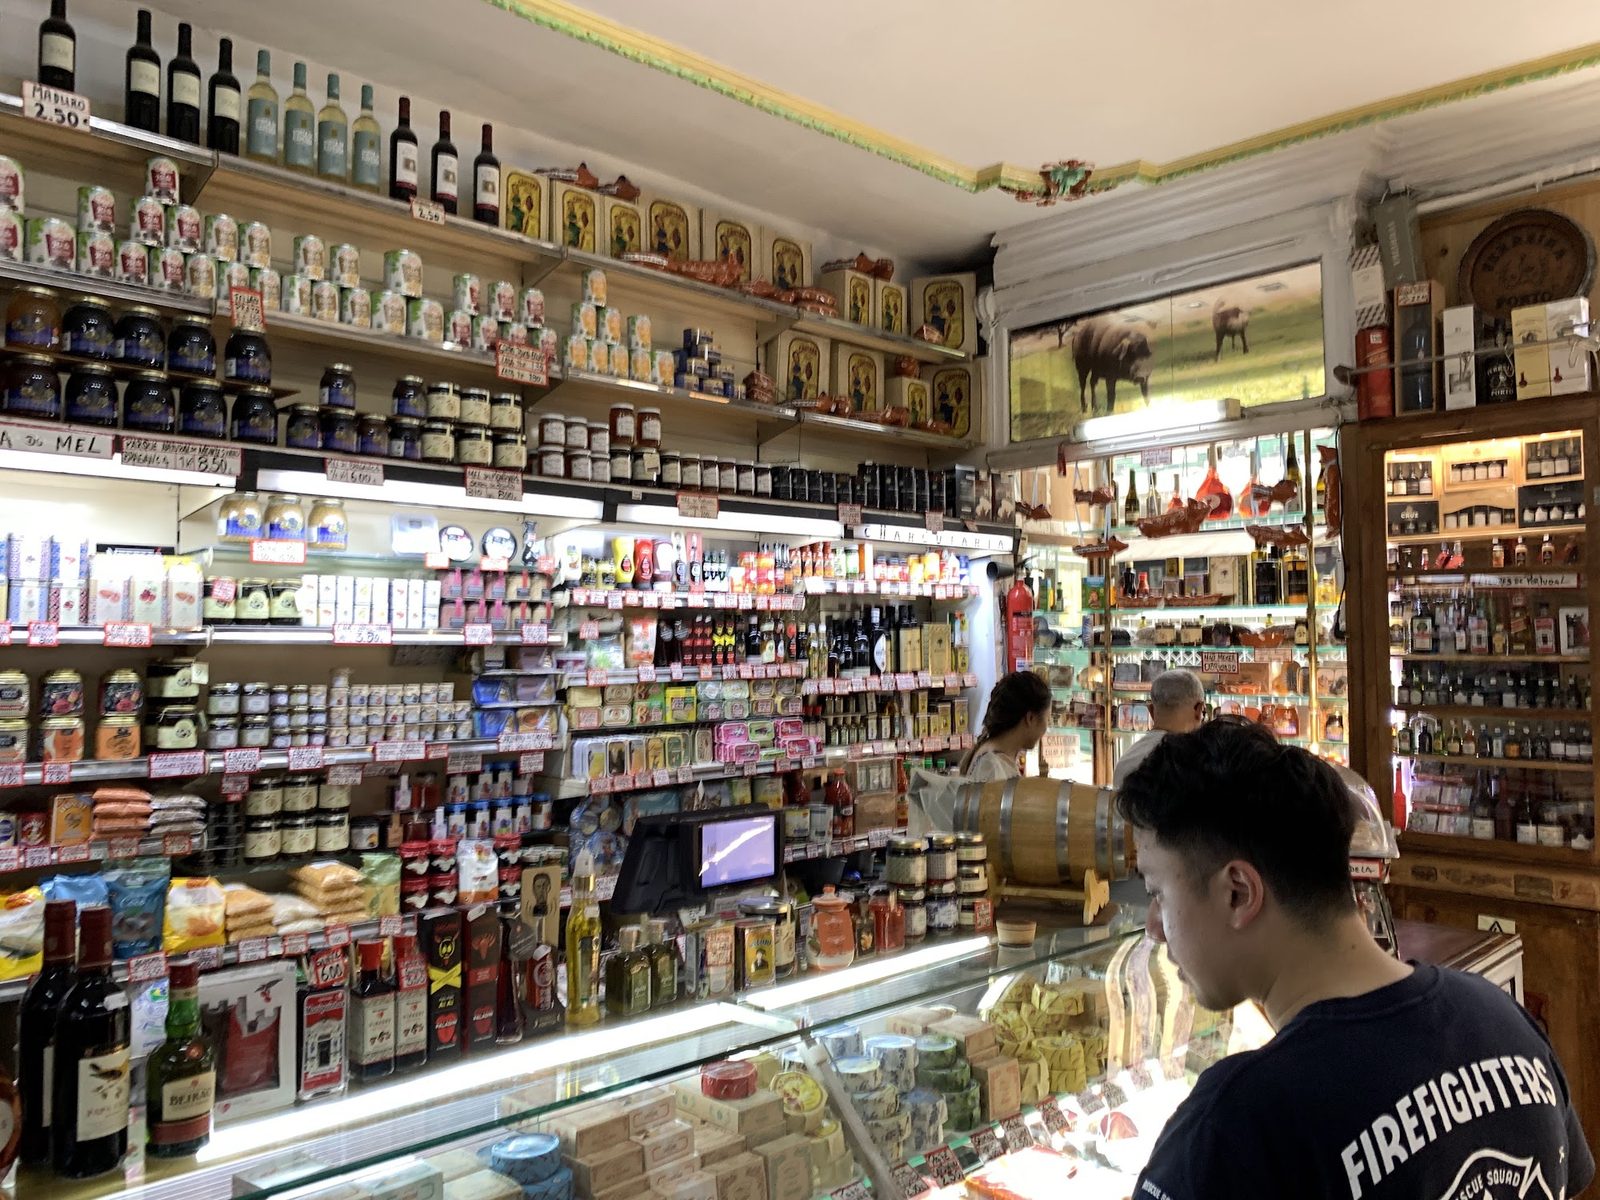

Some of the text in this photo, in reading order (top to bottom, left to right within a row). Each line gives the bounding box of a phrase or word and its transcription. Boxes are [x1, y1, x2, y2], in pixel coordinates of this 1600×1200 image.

[32, 85, 85, 111] MADURO
[56, 435, 101, 454] MEL
[1341, 1056, 1556, 1200] FIREFIGHTERS
[1455, 1174, 1484, 1200] SCUE
[1486, 1168, 1521, 1188] SQUAD
